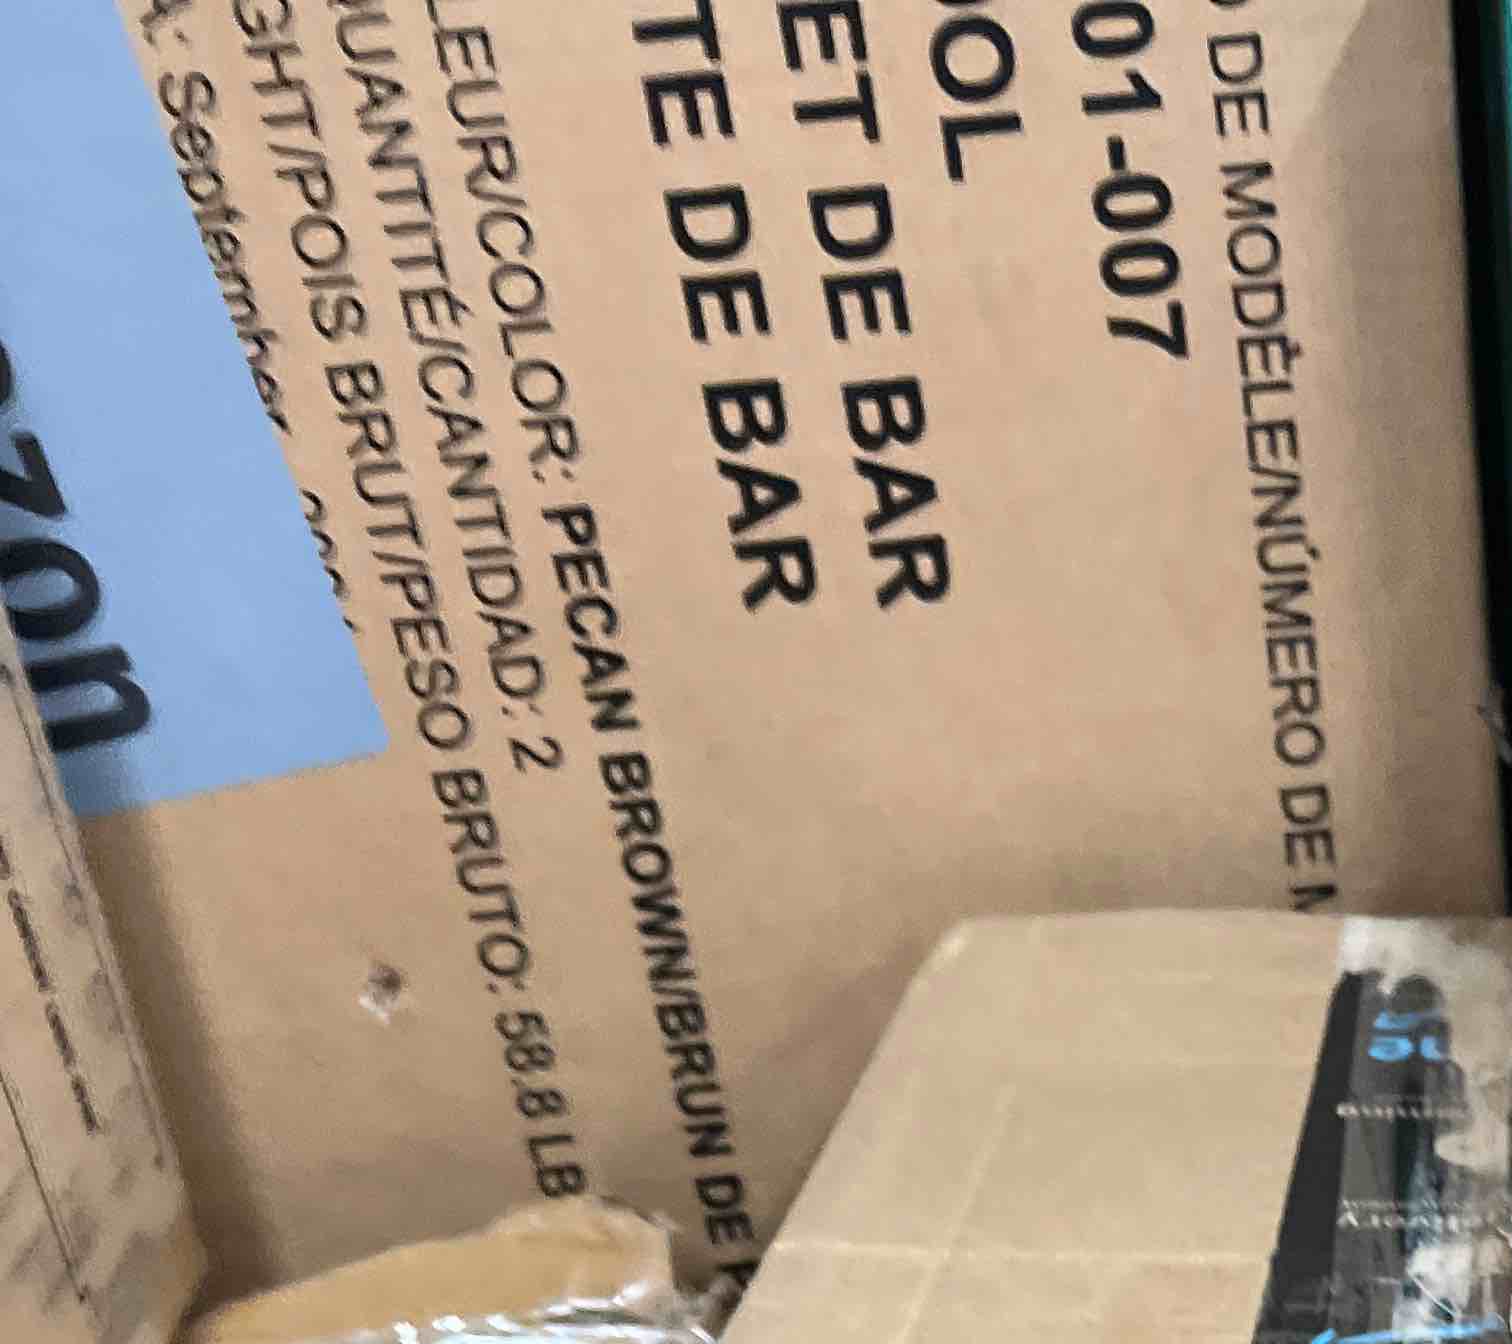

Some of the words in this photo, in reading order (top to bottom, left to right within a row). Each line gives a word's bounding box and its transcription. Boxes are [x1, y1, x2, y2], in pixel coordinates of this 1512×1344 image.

[631, 0, 736, 148] TE
[775, 0, 881, 144] ET
[928, 0, 1024, 183] OL
[663, 183, 775, 345] DE
[806, 181, 912, 344] DE
[701, 378, 817, 615] BAR
[840, 374, 952, 611] BAR
[1206, 29, 1273, 139] DE
[1279, 784, 1339, 872] DE
[327, 360, 472, 751] BRUT/PESO
[508, 735, 567, 775] 2
[432, 766, 531, 994] BRUTO:
[540, 502, 641, 734] PECAN
[598, 750, 734, 1160] BROWN/BRUN
[695, 1173, 754, 1248] DE
[494, 1007, 569, 1120] 58.8
[524, 1131, 588, 1200] LB
